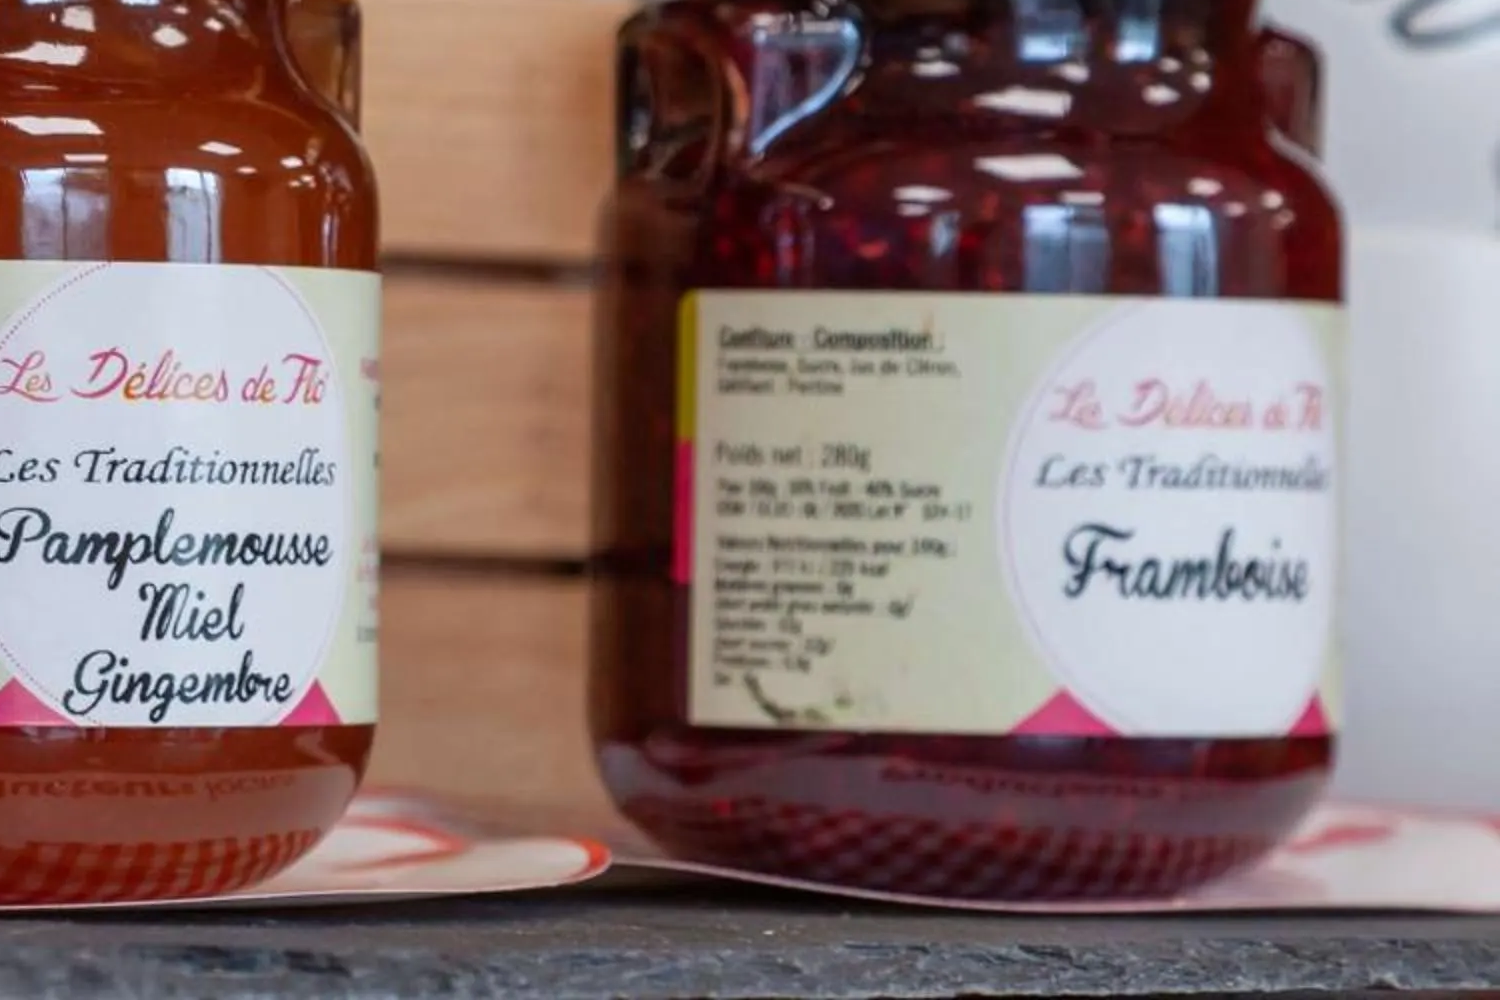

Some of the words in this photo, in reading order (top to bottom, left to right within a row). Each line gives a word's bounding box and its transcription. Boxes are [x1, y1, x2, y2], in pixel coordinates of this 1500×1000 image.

[70, 347, 228, 401] Délices
[241, 365, 276, 403] de
[73, 447, 336, 486] Traditionnelles
[1034, 453, 1108, 488] Les
[1062, 521, 1309, 600] Framboise
[138, 582, 245, 642] Miel
[63, 649, 295, 723] Gingembre
